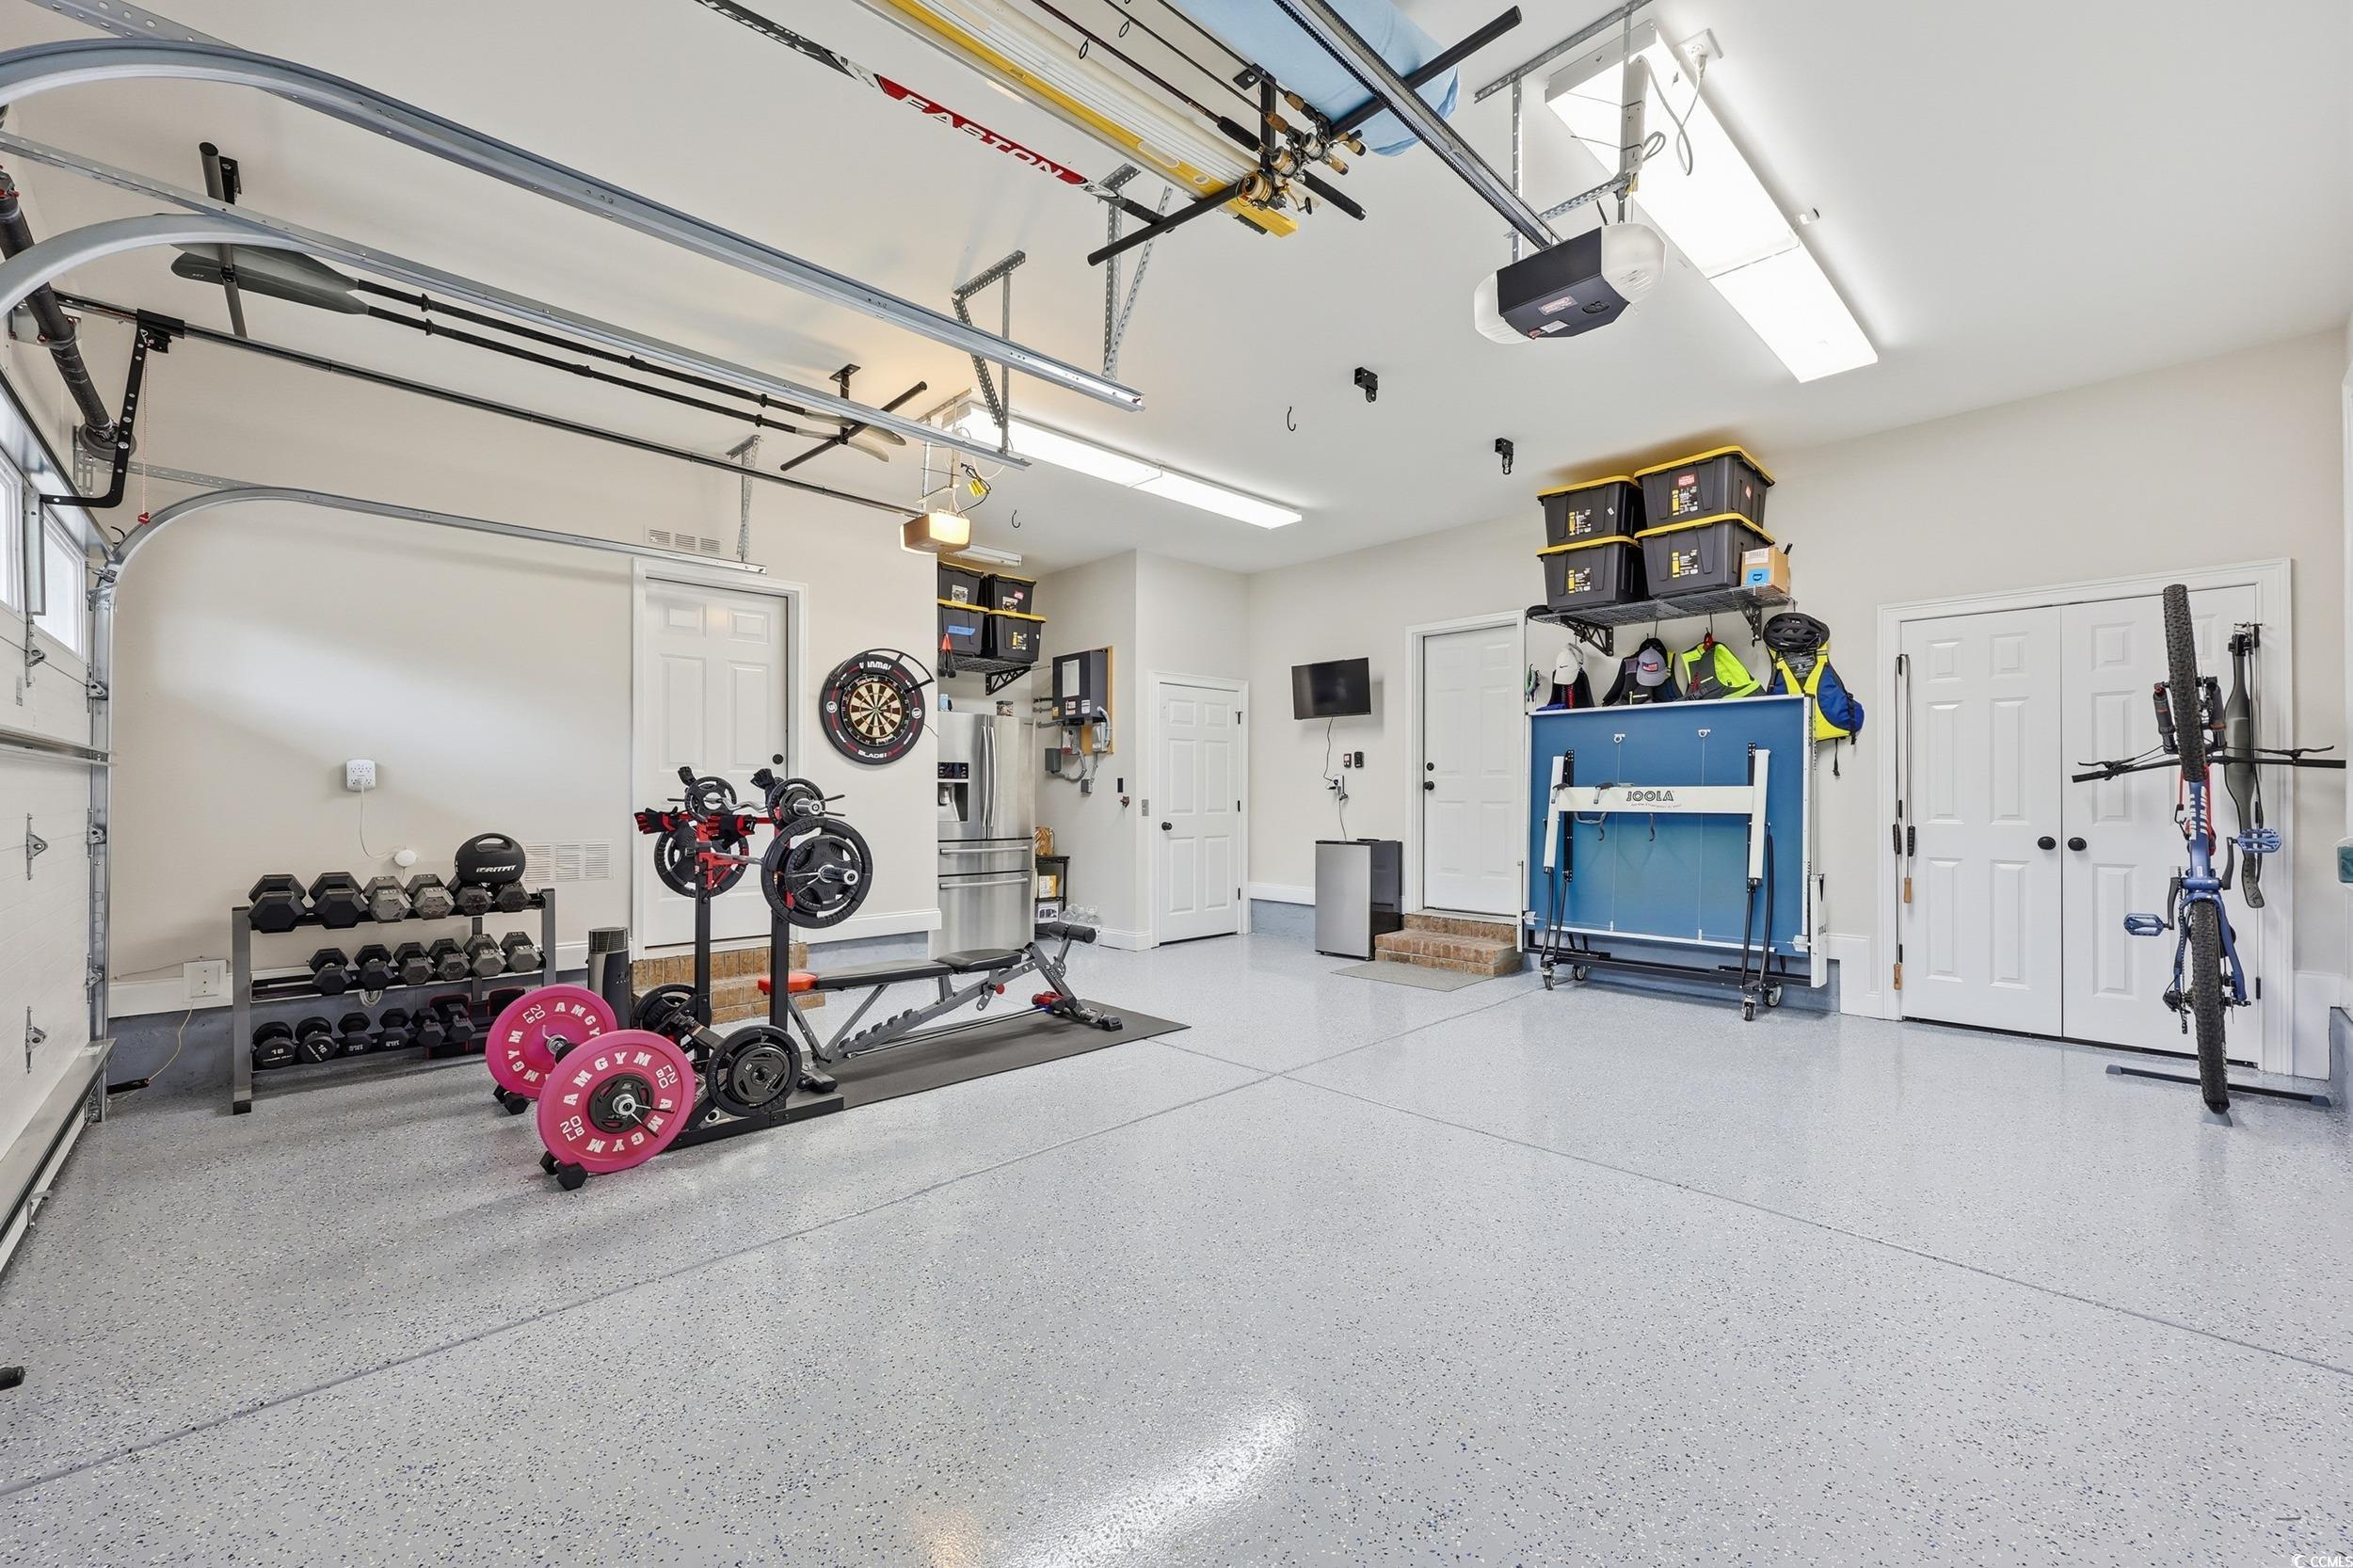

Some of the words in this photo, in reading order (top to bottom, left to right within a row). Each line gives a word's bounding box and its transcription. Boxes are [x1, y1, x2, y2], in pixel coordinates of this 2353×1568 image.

[900, 95, 1064, 179] EASTON
[1626, 790, 1673, 802] JOOLA
[522, 1011, 536, 1025] LB
[530, 1004, 546, 1020] 20
[554, 1001, 601, 1037] AMGY
[563, 1051, 652, 1106] AMGYM
[560, 1115, 582, 1134] 20
[566, 1128, 585, 1142] LB
